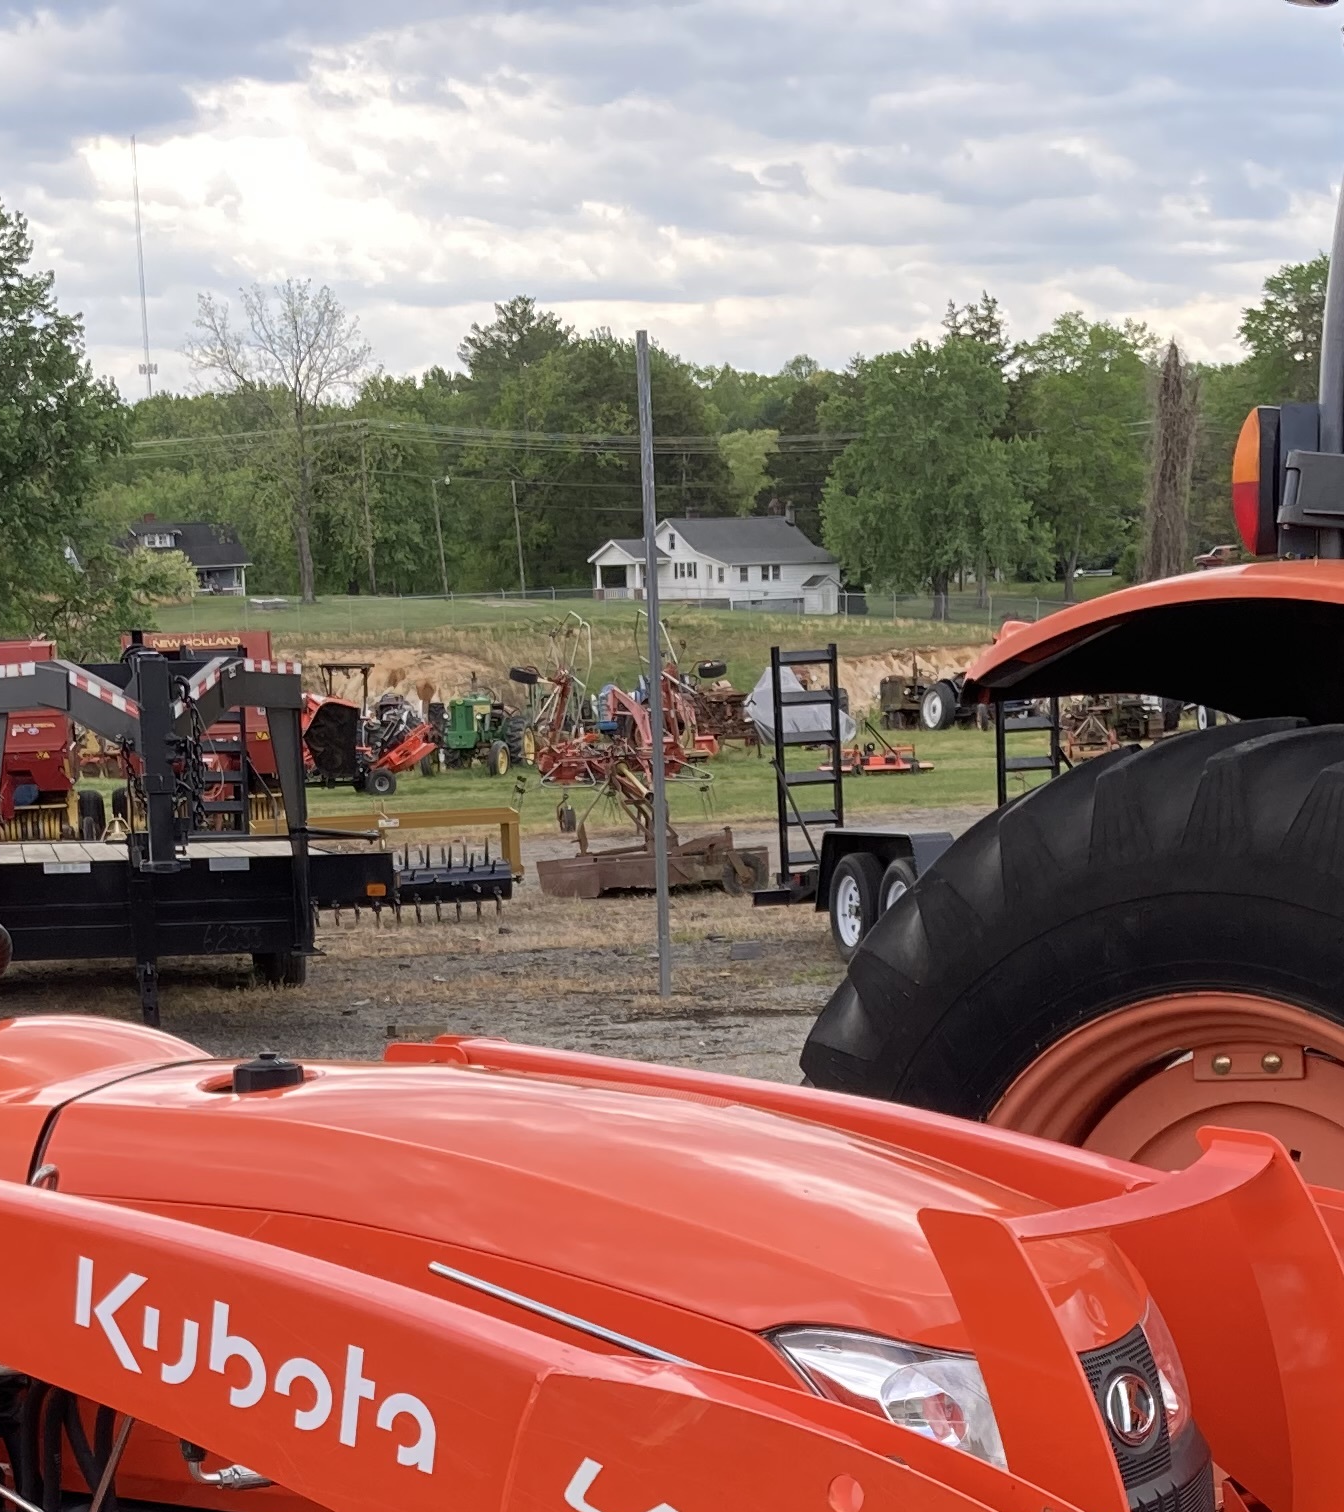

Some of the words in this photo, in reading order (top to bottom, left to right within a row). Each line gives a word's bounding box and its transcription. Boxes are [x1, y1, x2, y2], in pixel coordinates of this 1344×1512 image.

[152, 639, 181, 649] NEW
[182, 636, 241, 647] HOLLAND
[74, 1254, 438, 1475] Kubota
